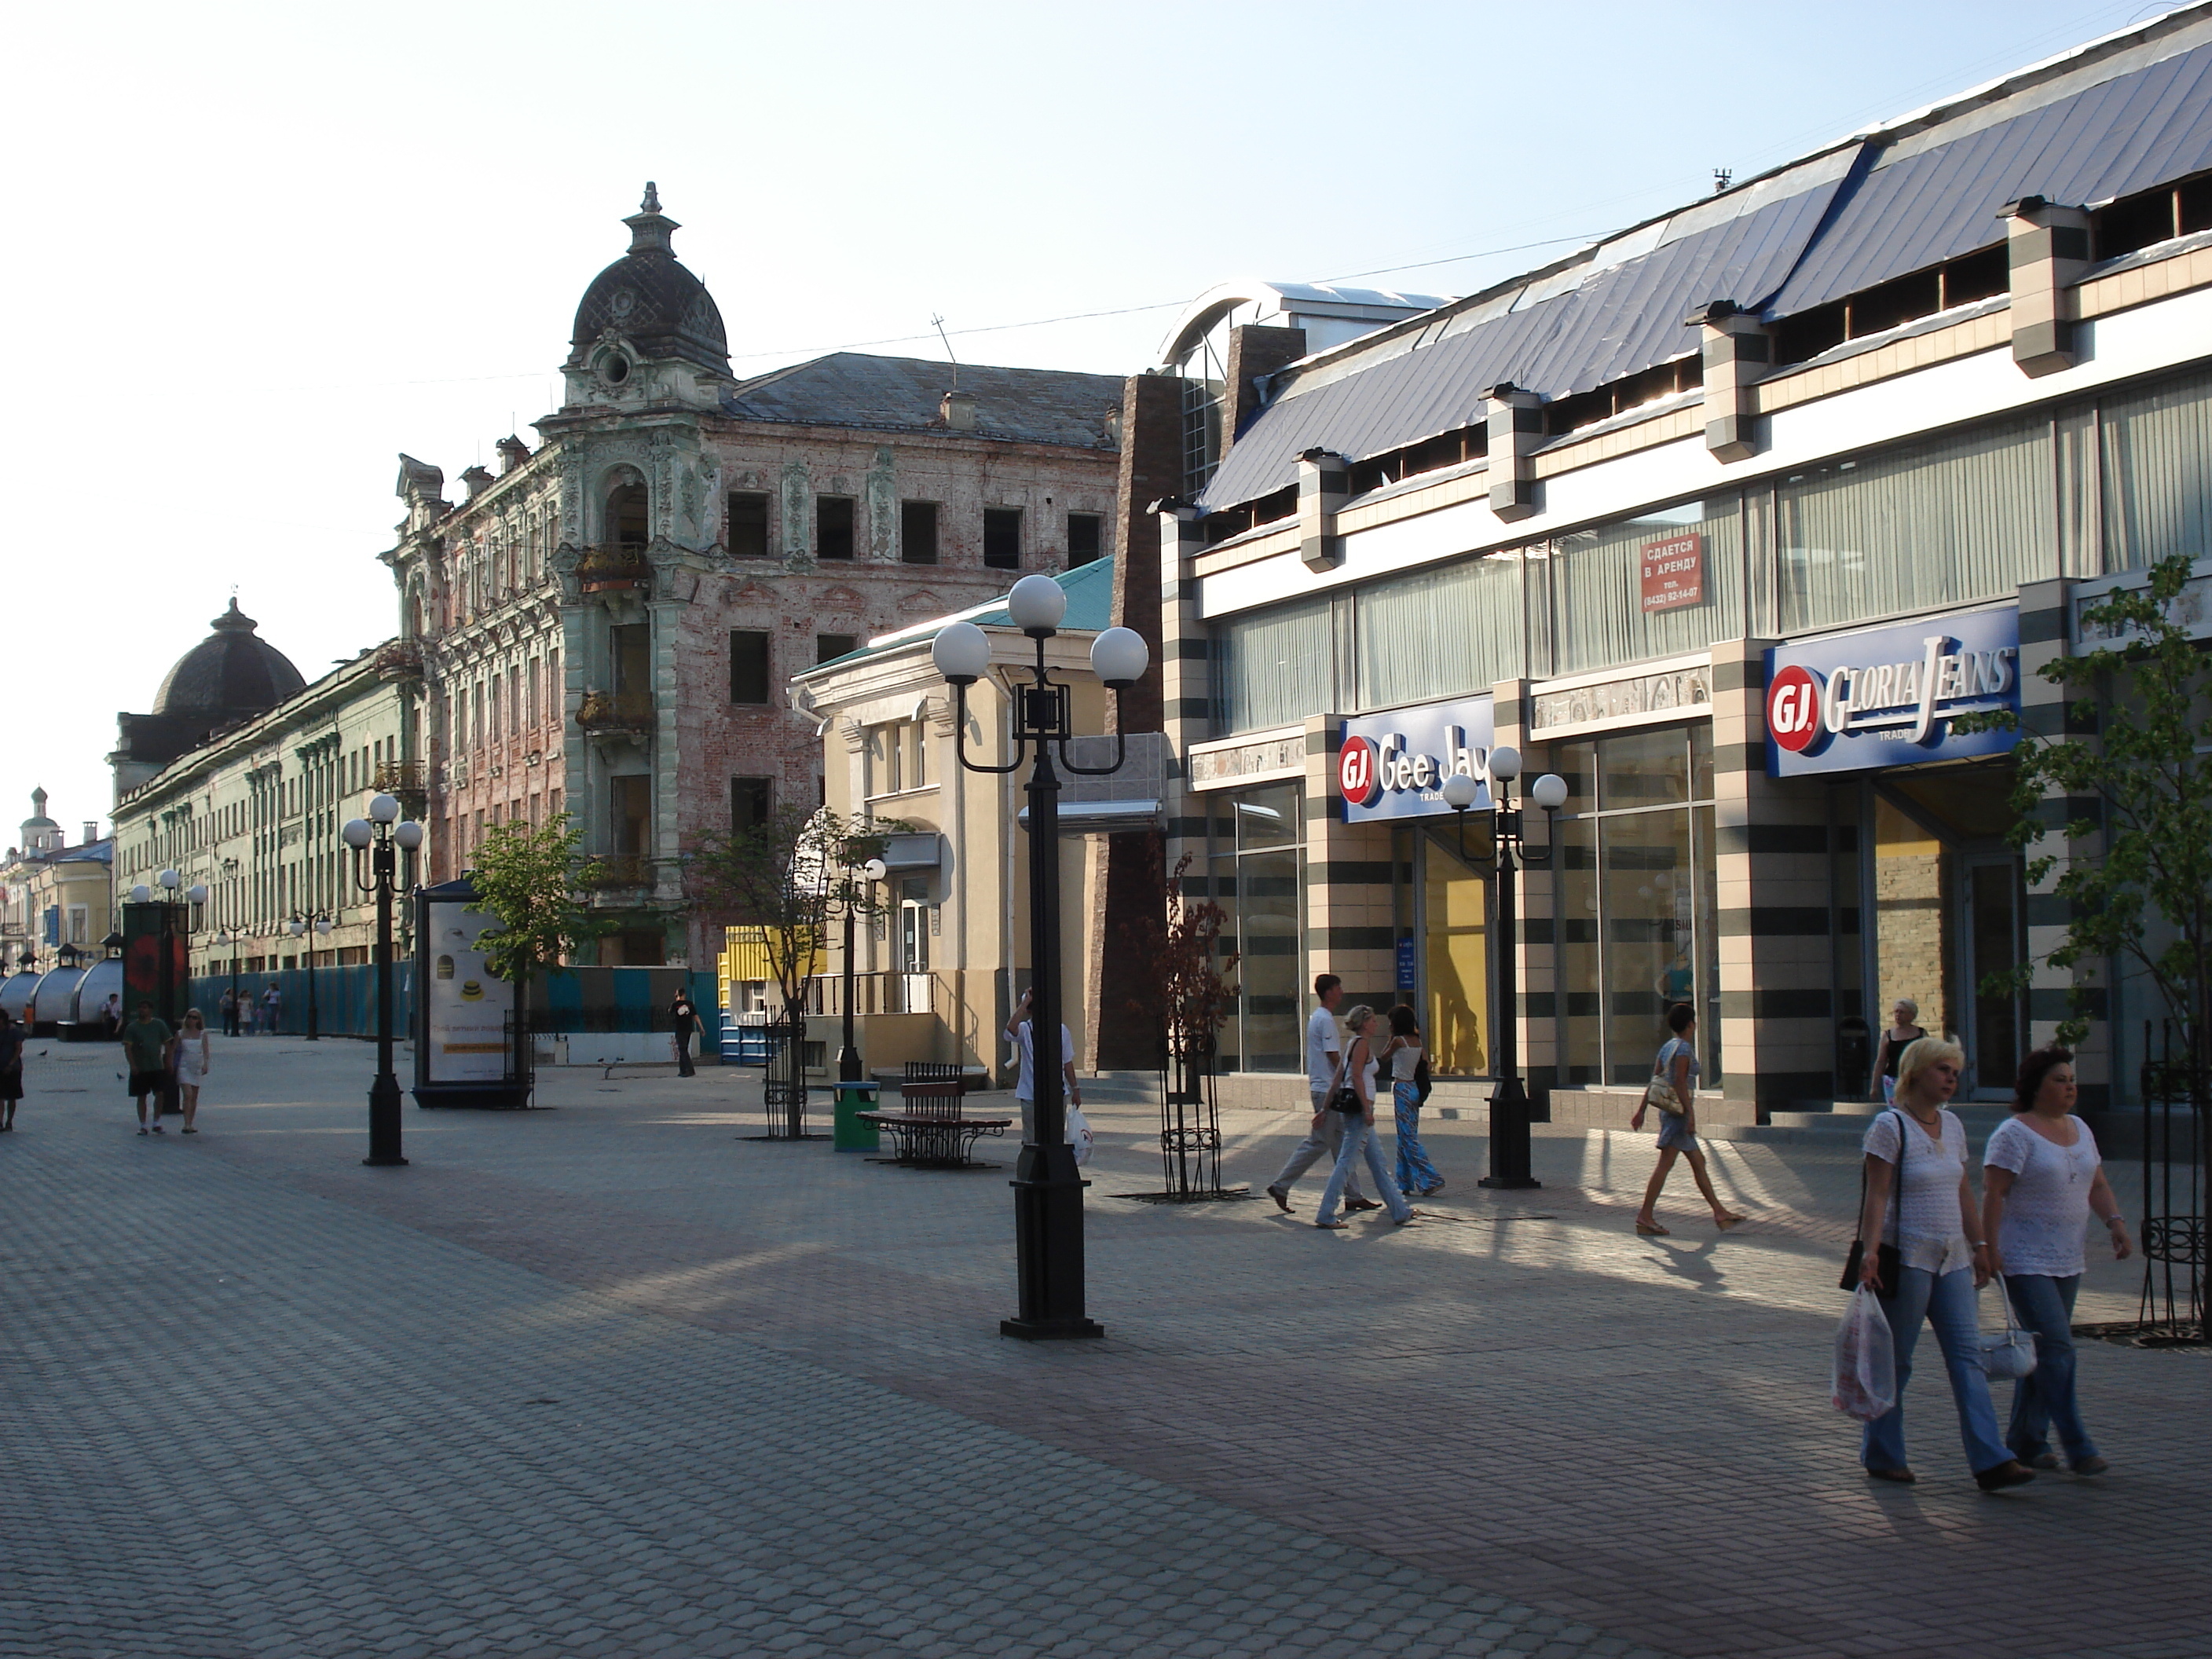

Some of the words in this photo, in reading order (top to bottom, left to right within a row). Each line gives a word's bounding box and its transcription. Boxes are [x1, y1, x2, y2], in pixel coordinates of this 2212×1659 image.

[1647, 540, 1694, 561] СДАЕТСЯ
[1644, 566, 1652, 578] В
[1657, 556, 1697, 576] АРЕНДУ
[1664, 580, 1679, 589] тел.
[1824, 661, 1921, 734] GLORIA
[1906, 635, 2015, 743] JEANS
[1379, 732, 1434, 791] Gee
[1439, 724, 1492, 802] Jay
